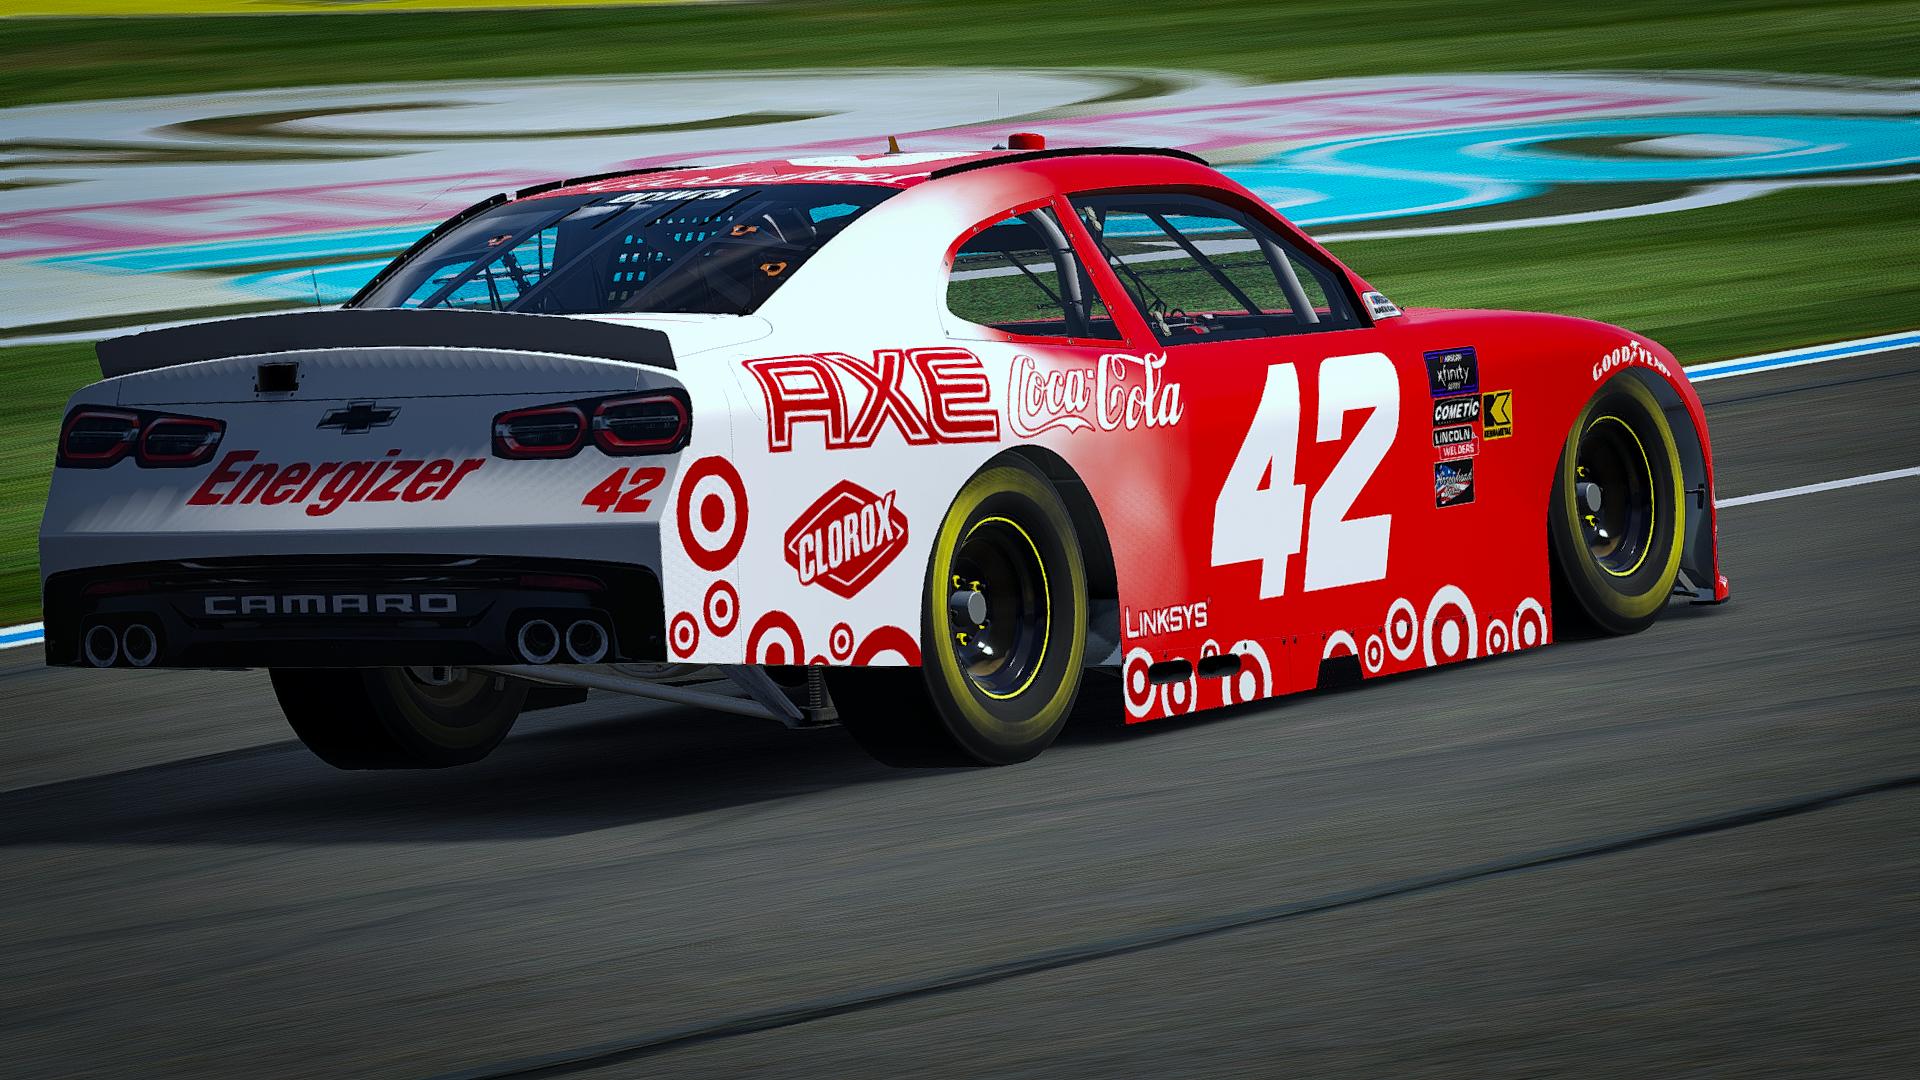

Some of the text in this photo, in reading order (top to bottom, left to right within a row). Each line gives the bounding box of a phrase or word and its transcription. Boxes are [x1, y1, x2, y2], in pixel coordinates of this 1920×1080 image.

[1437, 364, 1470, 386] xfinity
[1592, 342, 1672, 382] GOODYEAR
[741, 347, 1001, 452] AXE
[1435, 399, 1480, 421] COMETIC
[1434, 428, 1471, 445] LINCOLN
[1442, 443, 1474, 457] WELDERS
[187, 450, 485, 516] Energizer
[581, 467, 666, 513] 42
[1211, 352, 1400, 600] 42
[798, 493, 894, 584] CLOROX
[204, 593, 457, 616] CAMARO
[1125, 602, 1208, 638] LINKSYS
